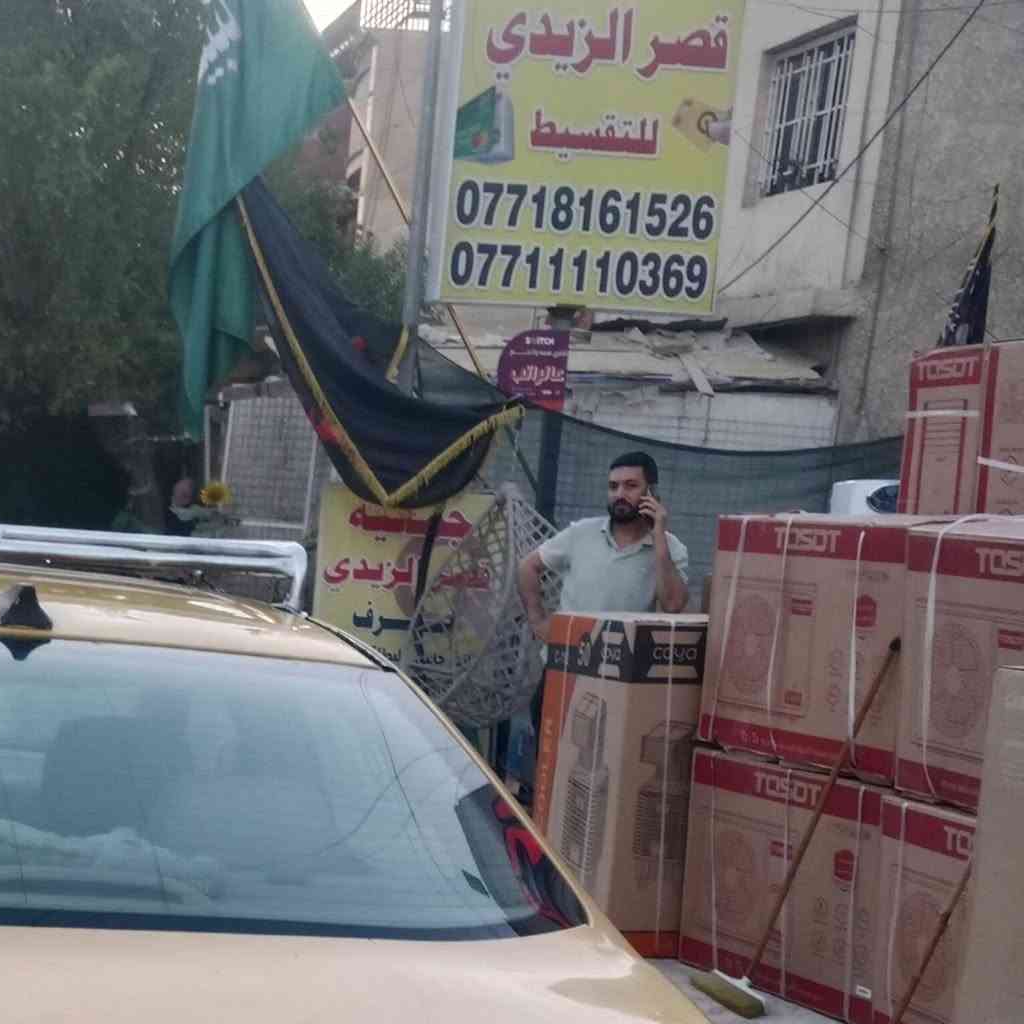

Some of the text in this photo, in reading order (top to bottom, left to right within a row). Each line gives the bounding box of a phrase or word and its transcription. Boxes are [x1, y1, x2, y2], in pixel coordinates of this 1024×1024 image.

[486, 8, 728, 80] قصر الزيدي
[530, 108, 659, 160] للتقسيط
[456, 179, 715, 240] 07718161526
[450, 241, 707, 298] 07711110369
[917, 356, 978, 381] TOSOT
[774, 527, 842, 553] TOSOT
[323, 556, 416, 592] لزيدي
[753, 771, 822, 806] TOSOT
